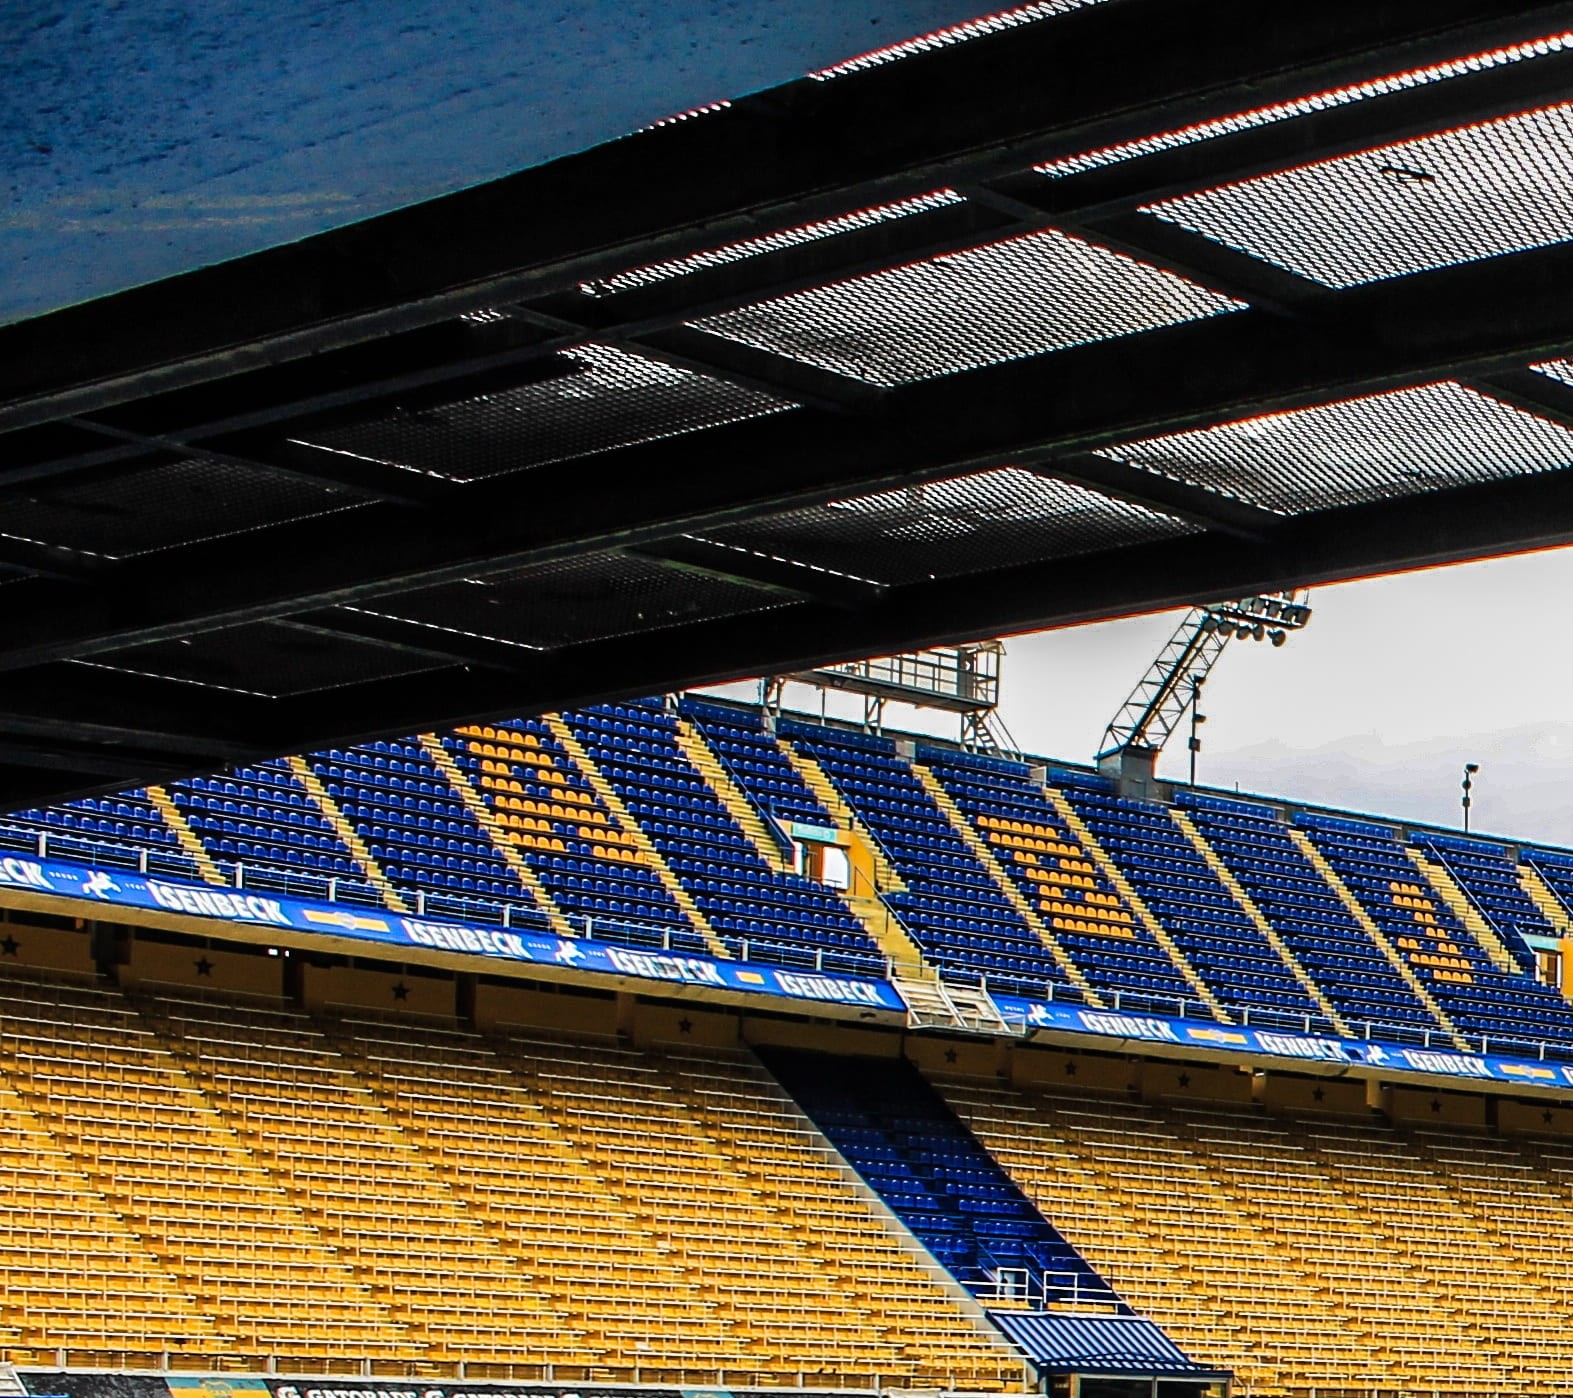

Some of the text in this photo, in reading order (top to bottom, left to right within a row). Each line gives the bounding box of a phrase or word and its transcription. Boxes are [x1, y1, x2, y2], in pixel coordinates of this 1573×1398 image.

[149, 880, 293, 925] ISENBECK
[403, 916, 532, 959] ISENBECK
[606, 947, 728, 985] ISENBECK
[775, 969, 889, 1006] ISENBECK
[1079, 1010, 1178, 1041] ISENBECK
[1255, 1031, 1351, 1063] ISENBECK
[1402, 1049, 1492, 1078] ISENBECK
